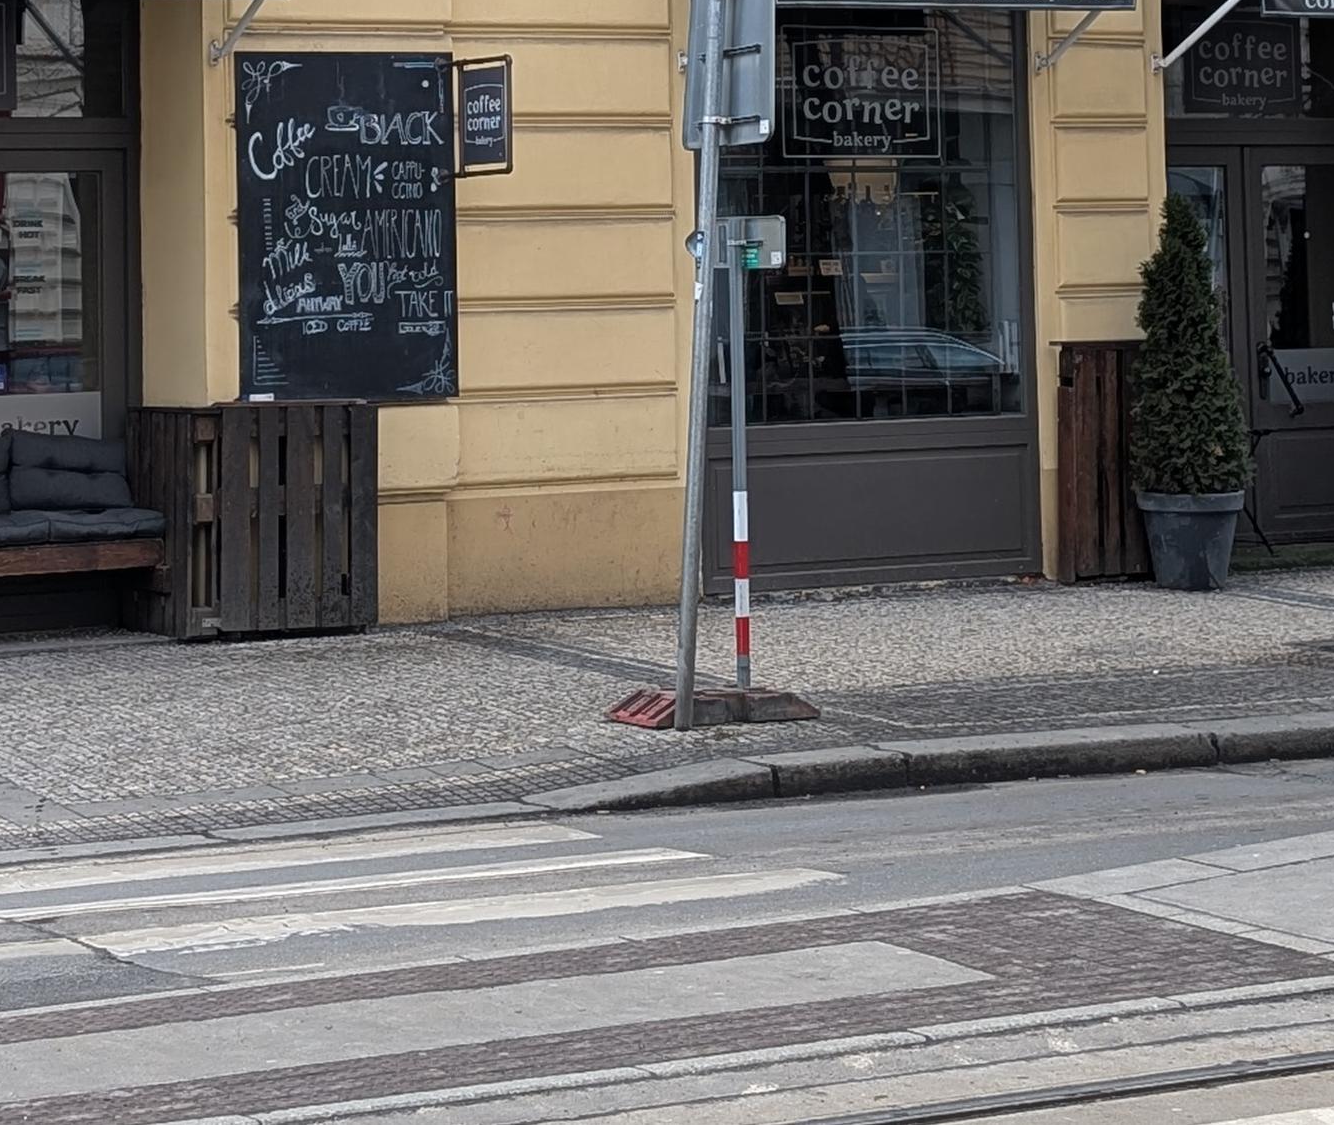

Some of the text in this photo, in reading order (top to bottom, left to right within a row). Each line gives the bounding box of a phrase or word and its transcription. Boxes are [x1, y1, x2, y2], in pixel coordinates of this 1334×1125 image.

[1198, 33, 1288, 61] coffee
[802, 55, 919, 91] coffee
[1199, 64, 1287, 88] corner
[467, 95, 501, 115] coffee
[803, 97, 920, 124] corner
[1222, 92, 1267, 109] bakery
[467, 115, 501, 131] corner
[248, 118, 315, 180] Coffee
[832, 130, 893, 153] bakery
[306, 154, 372, 199] CREAM
[19, 231, 40, 239] HOT
[308, 206, 362, 239] Sugar
[361, 209, 442, 258] AMERICANO
[262, 241, 313, 280] Milk
[338, 261, 385, 305] YOU
[394, 290, 439, 317] TAKE
